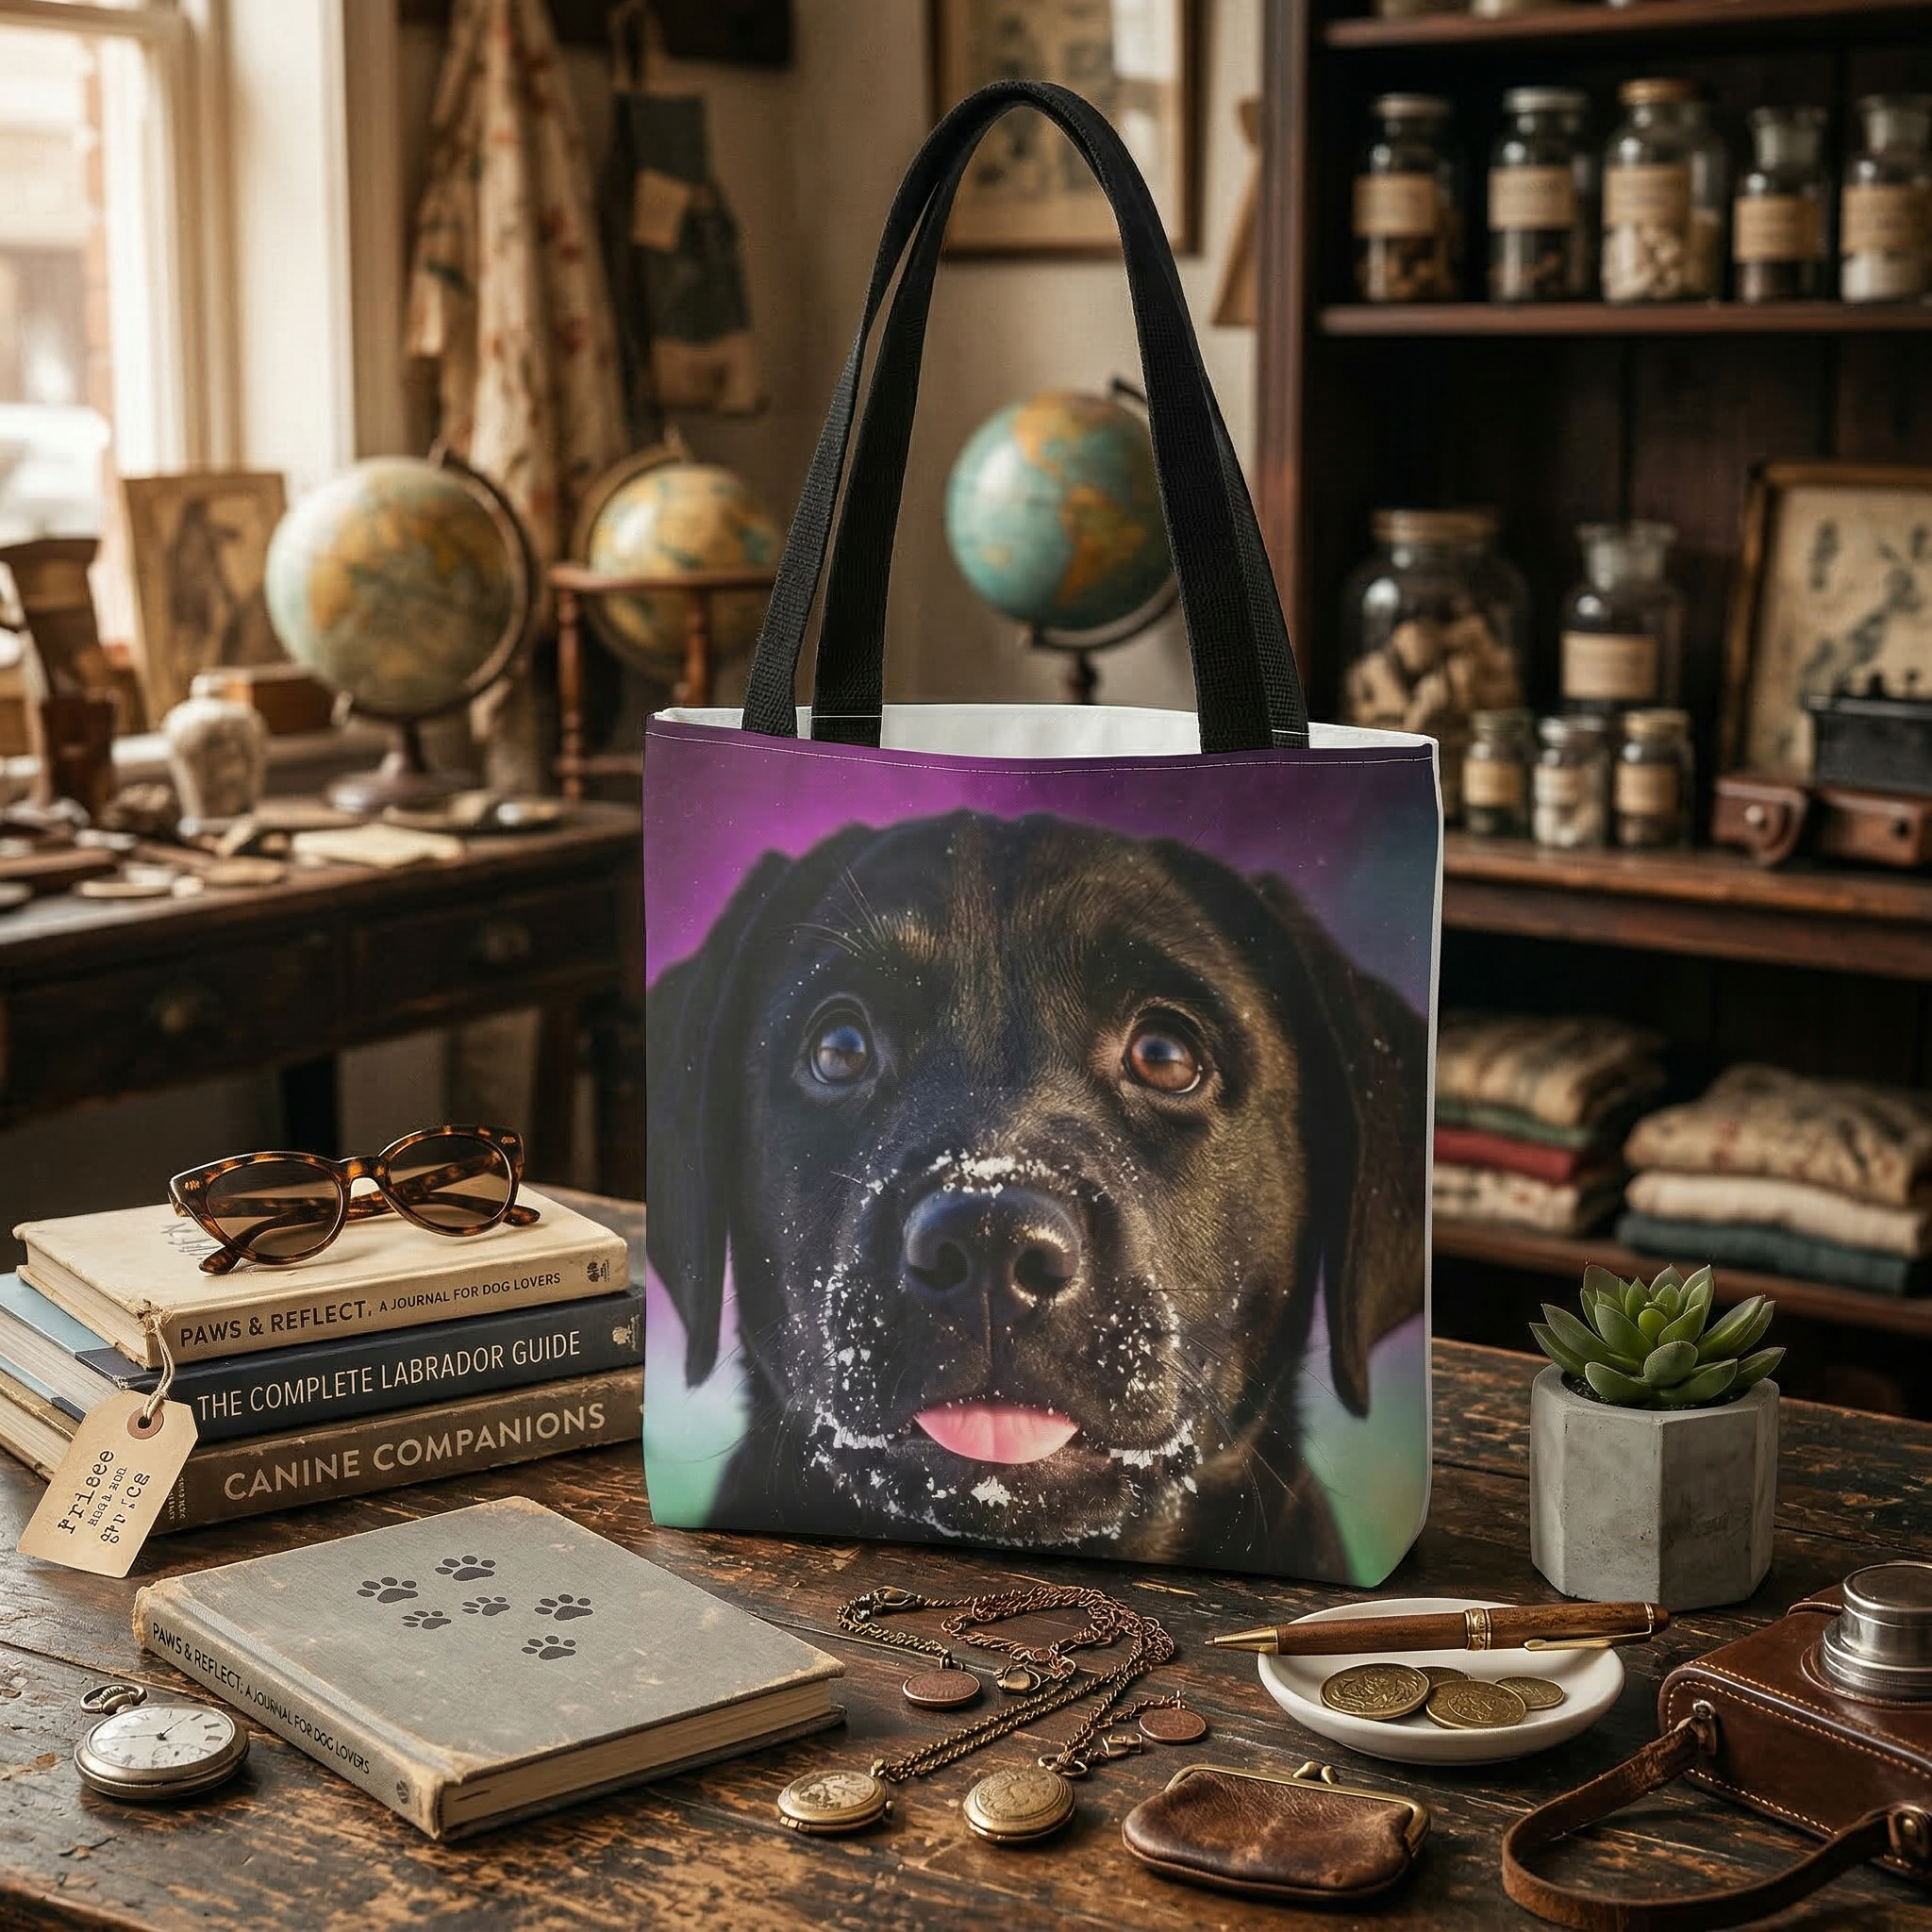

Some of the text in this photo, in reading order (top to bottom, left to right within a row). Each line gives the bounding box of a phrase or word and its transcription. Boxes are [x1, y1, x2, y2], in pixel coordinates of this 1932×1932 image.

[180, 1320, 242, 1347] PAWS
[248, 1316, 264, 1337] &
[379, 1300, 389, 1312] A
[391, 1291, 451, 1311] JOURNAL
[453, 1286, 479, 1301] FOR
[482, 1281, 510, 1295] DOG
[513, 1273, 561, 1291] LOVERS
[197, 1390, 242, 1421] THE
[250, 1367, 373, 1412] COMPLETE
[381, 1344, 504, 1390] LABRADOR
[511, 1330, 581, 1366] GUIDE
[224, 1449, 360, 1501] CANINE
[373, 1403, 606, 1471] COMPANIONS
[153, 1622, 182, 1654] PAWS
[184, 1642, 192, 1662] &
[194, 1648, 243, 1694] REFLECT:
[245, 1685, 253, 1699] A
[253, 1688, 293, 1725] JOURNAL
[294, 1715, 312, 1738] FOR
[313, 1727, 334, 1751] DOG
